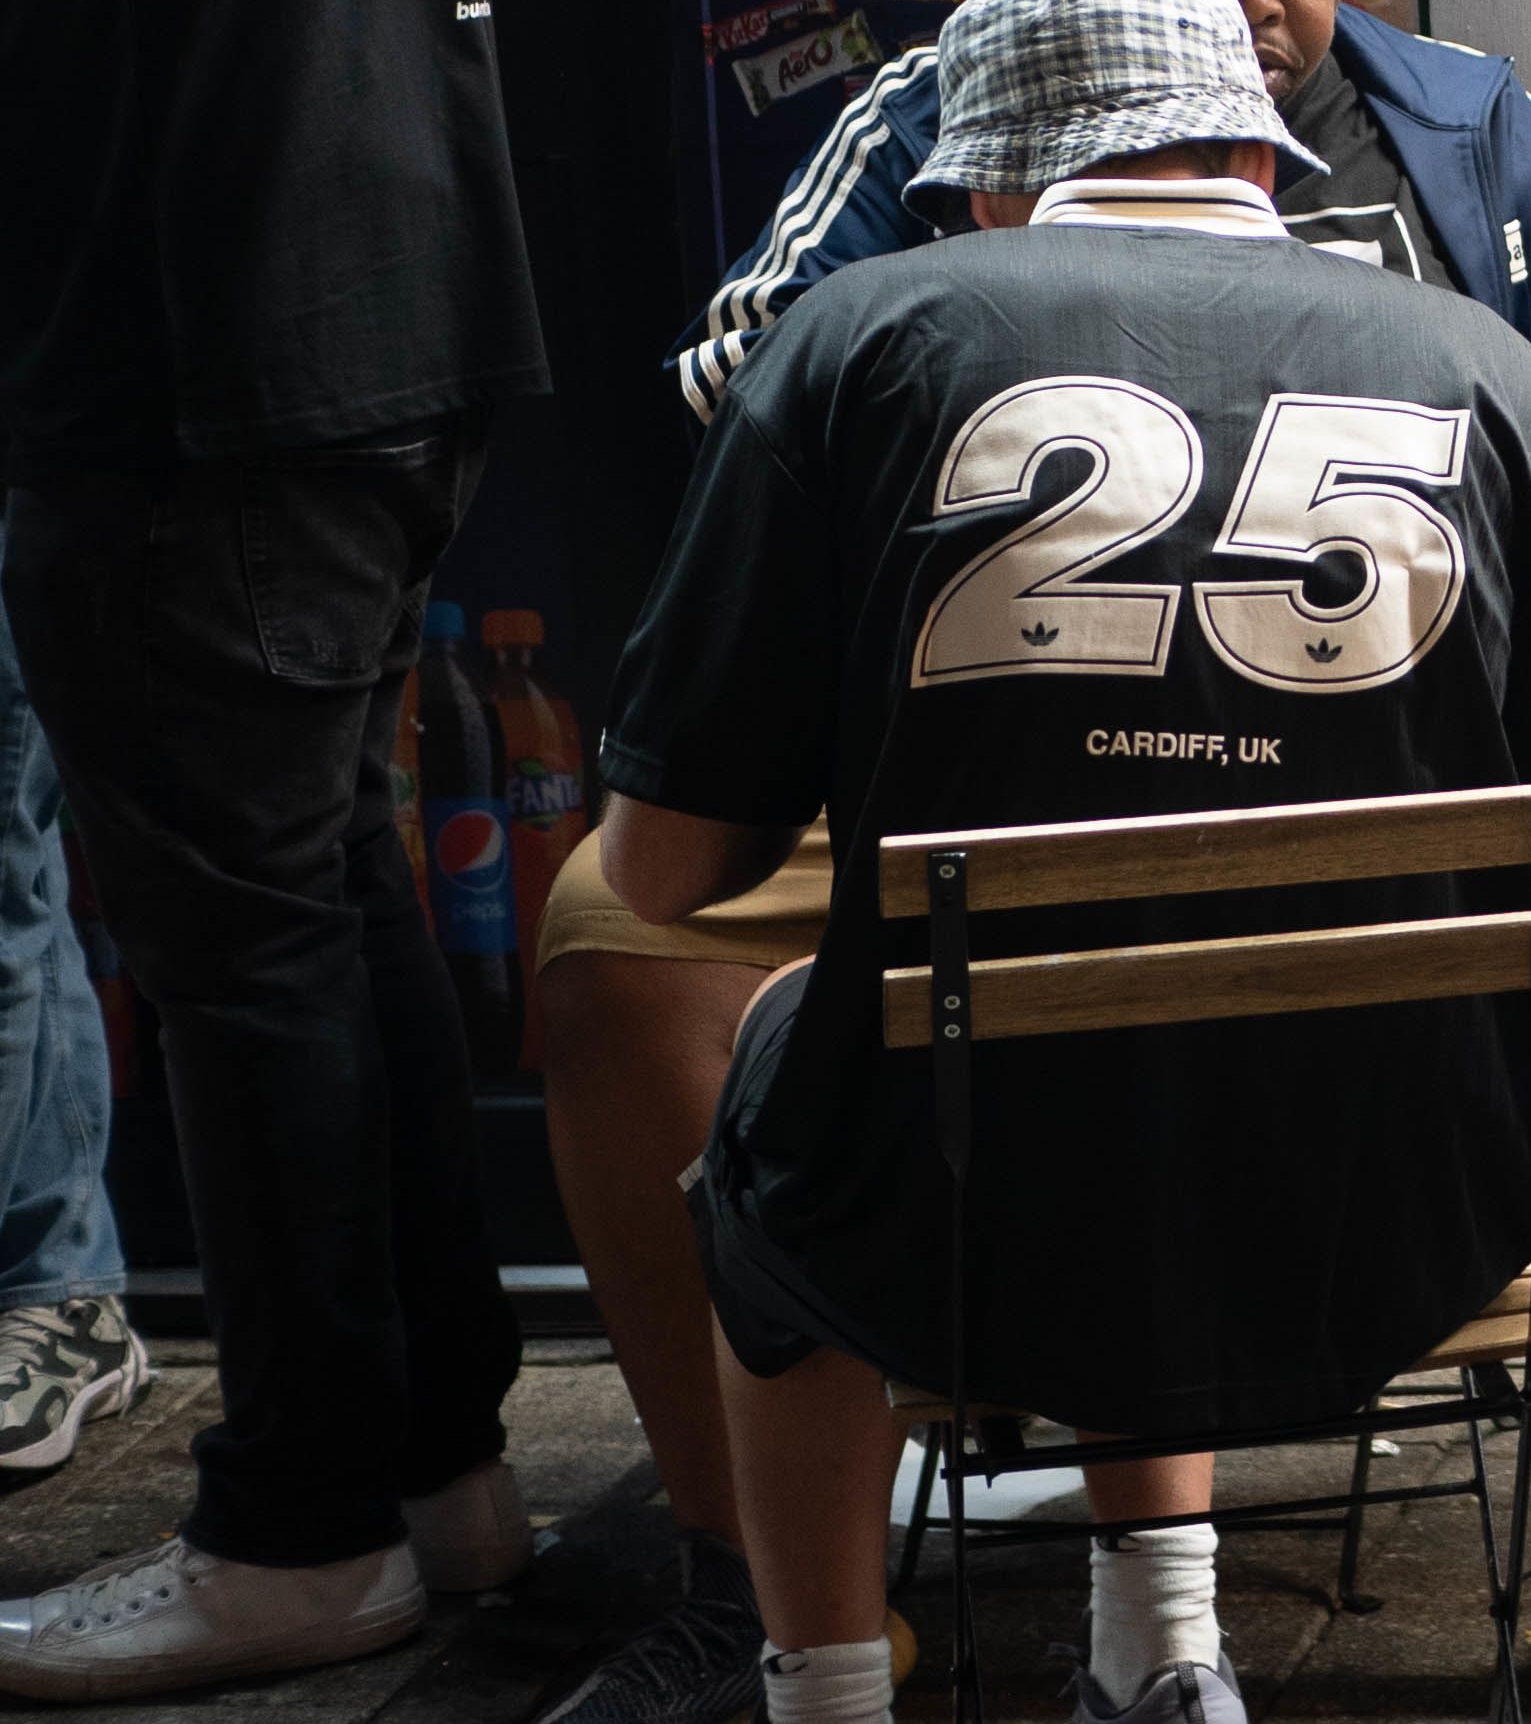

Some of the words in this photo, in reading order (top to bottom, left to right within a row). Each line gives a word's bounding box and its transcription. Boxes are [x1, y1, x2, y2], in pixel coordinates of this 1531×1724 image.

[911, 375, 1471, 695] 25
[1086, 728, 1230, 766] CARDIFF,
[1237, 735, 1282, 764] UK
